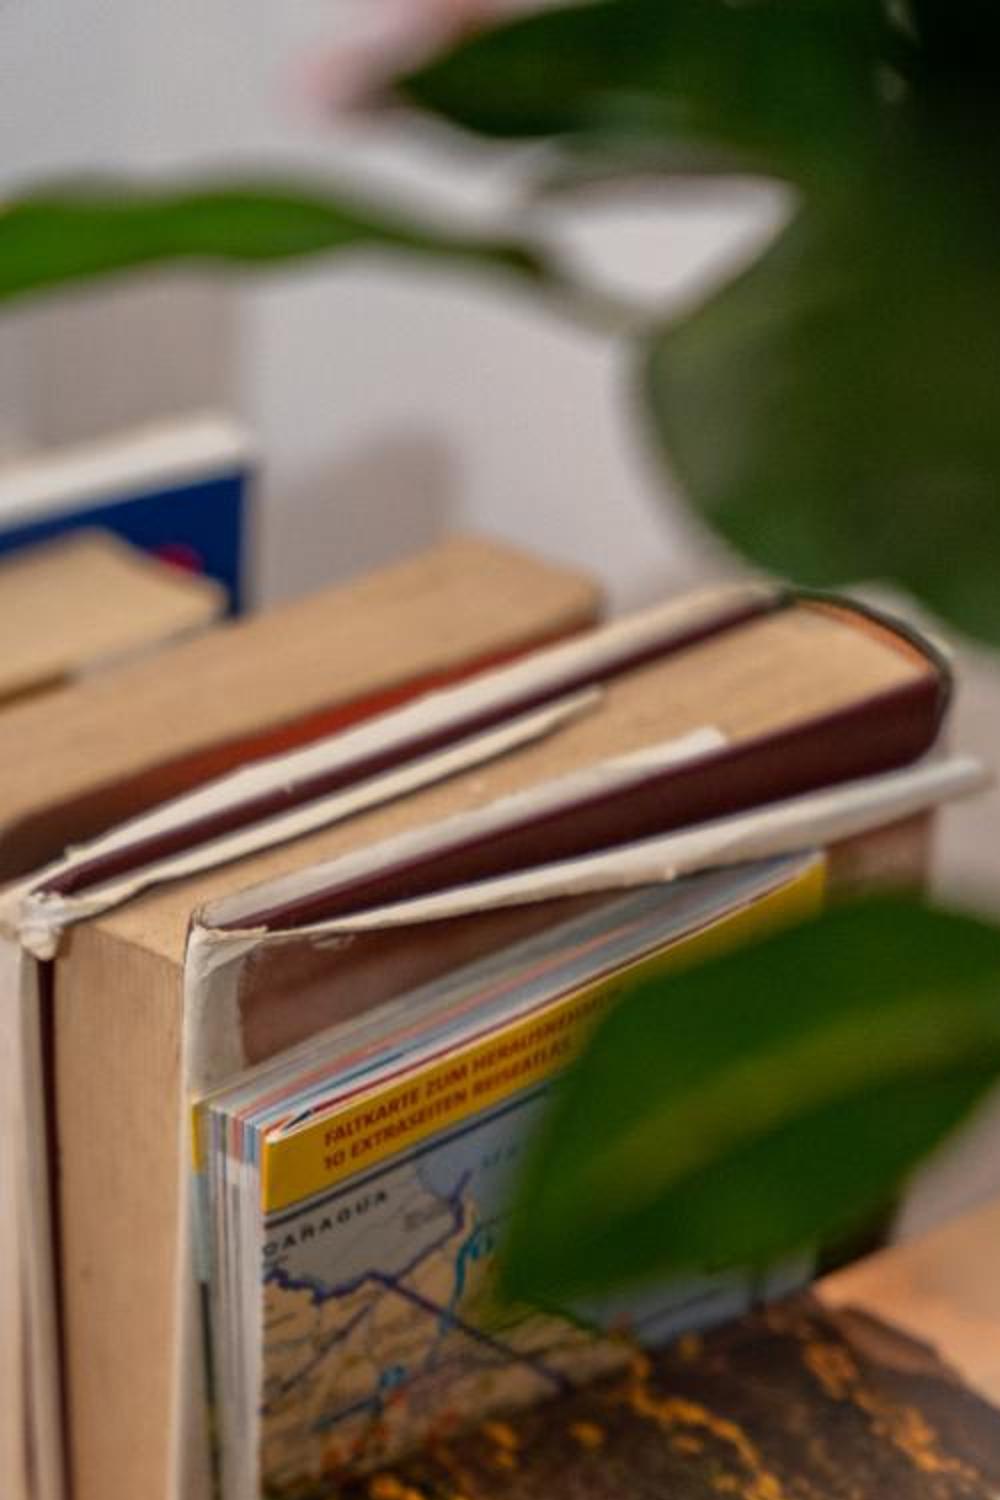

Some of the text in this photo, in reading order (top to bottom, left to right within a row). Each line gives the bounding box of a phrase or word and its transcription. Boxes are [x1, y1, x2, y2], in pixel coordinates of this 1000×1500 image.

[324, 1085, 420, 1147] FALTKARTE
[426, 1063, 469, 1099] ZUM
[324, 1149, 345, 1171] 10
[351, 1087, 468, 1159] EXTRASEITEN
